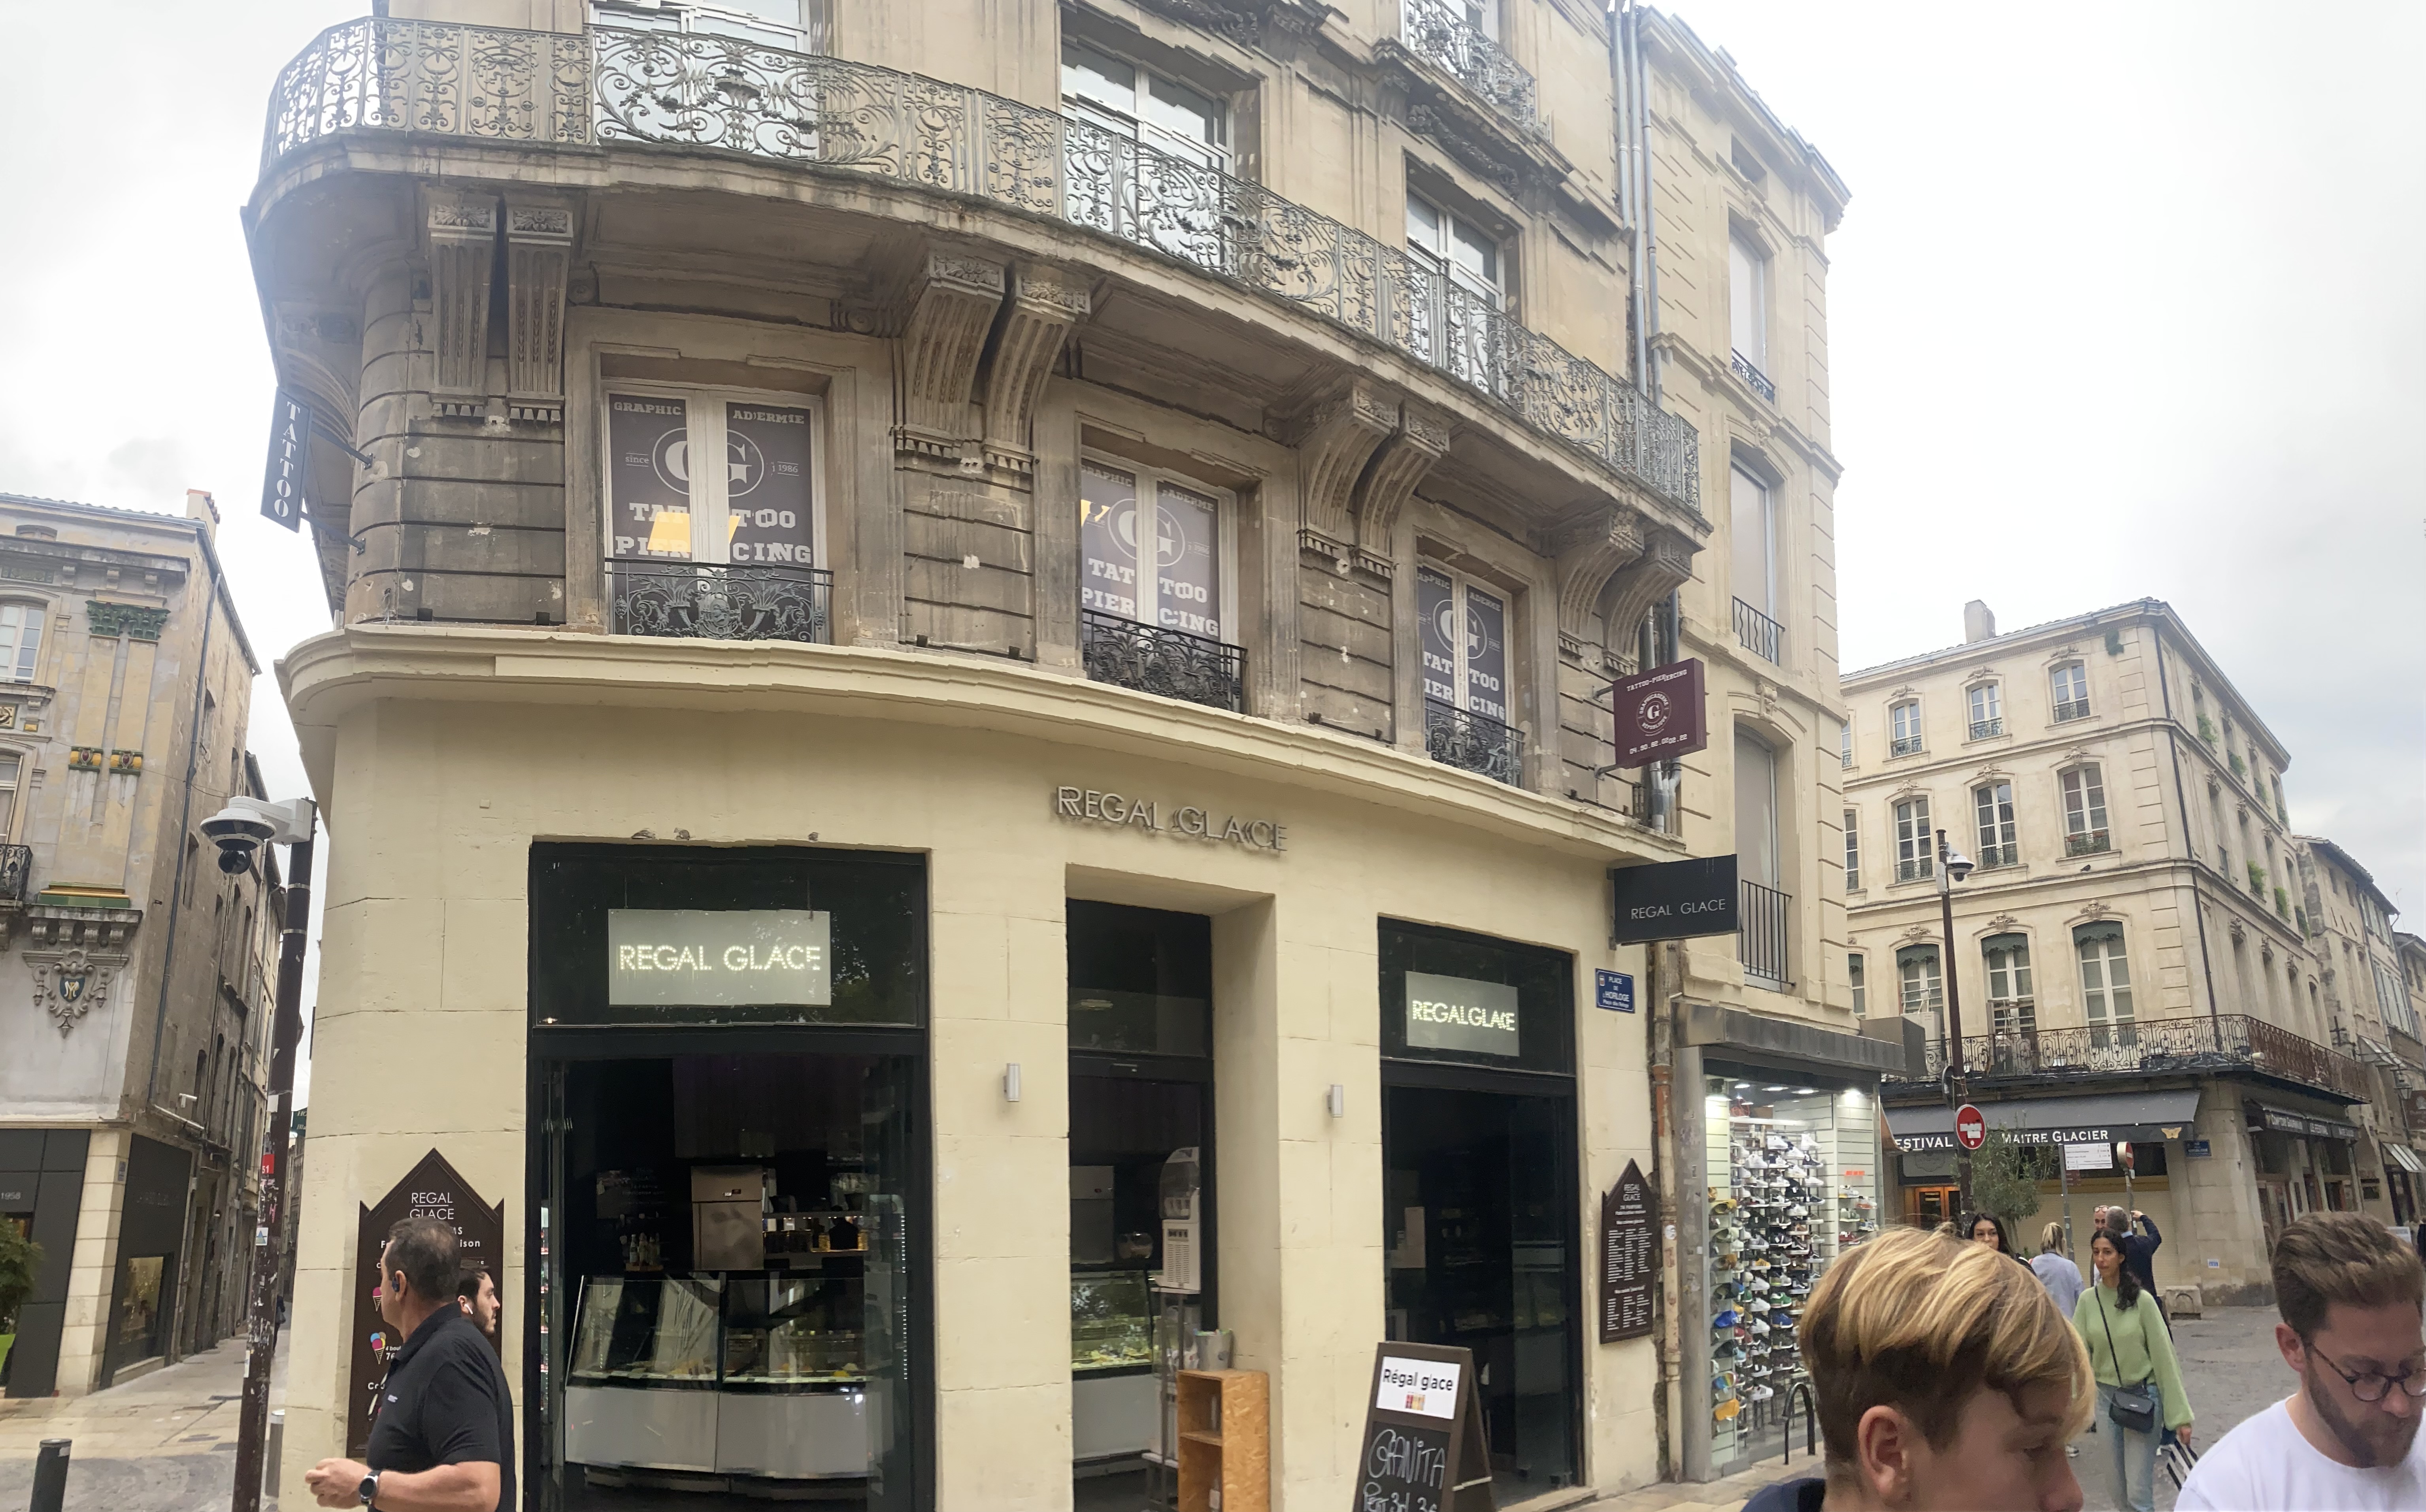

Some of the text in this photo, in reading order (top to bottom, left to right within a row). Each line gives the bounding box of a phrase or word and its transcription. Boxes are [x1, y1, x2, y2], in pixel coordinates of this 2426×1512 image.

[614, 402, 682, 416] GRAPHIC
[274, 401, 300, 517] TATTOO
[625, 455, 649, 464] since
[778, 464, 799, 473] 1986
[1423, 677, 1454, 702] IER
[1057, 786, 1287, 852] REGAL GLACE
[1631, 898, 1726, 920] REGAL GLACE
[619, 945, 821, 971] REGAL GLACE
[1895, 1137, 1954, 1149] ESTIVAL
[2052, 1129, 2109, 1143] GLACIER
[411, 1192, 453, 1204] REGAL
[1383, 1369, 1453, 1391] Régal glace
